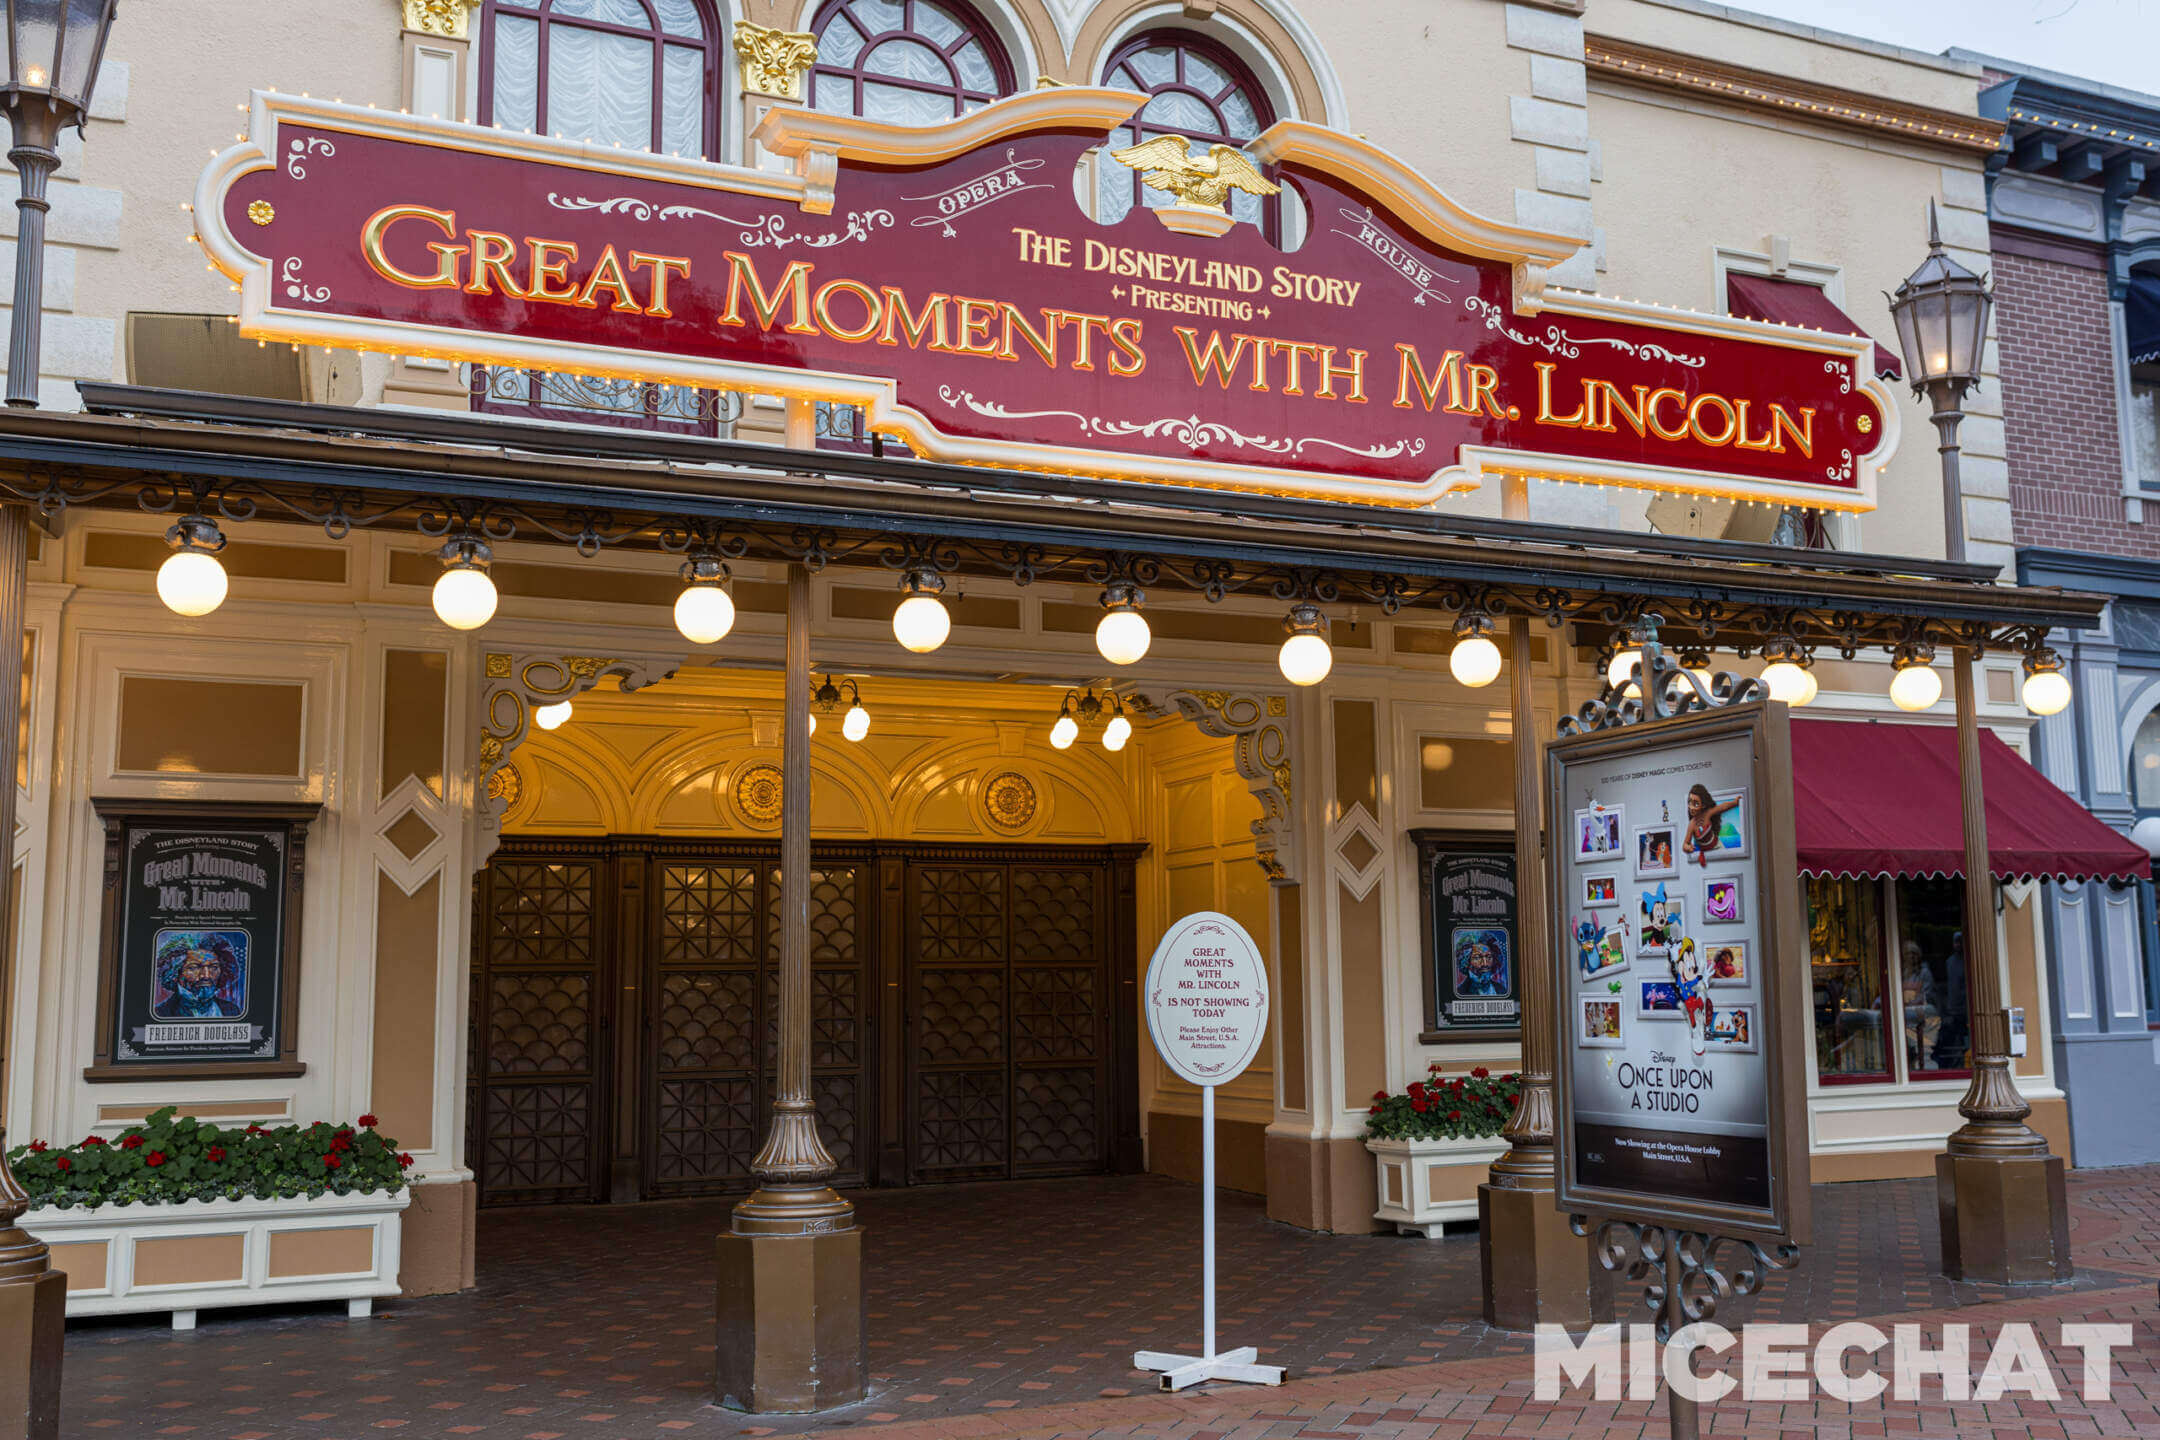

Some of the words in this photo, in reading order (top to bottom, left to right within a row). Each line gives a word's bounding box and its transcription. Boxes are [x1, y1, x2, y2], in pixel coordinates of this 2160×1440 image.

[938, 170, 1026, 215] OPERA
[1358, 224, 1433, 288] HOUSE
[1012, 227, 1073, 268] THE
[1084, 238, 1264, 294] DISNEYLAND
[1271, 265, 1362, 308] STORY
[1130, 284, 1253, 322] PRESENTING
[361, 203, 692, 319] GREAT
[720, 250, 1147, 378] MOMENTS
[1173, 324, 1370, 404] WITH
[1395, 343, 1521, 421] MR.
[1535, 361, 1817, 459] LINCOLN
[1649, 768, 1666, 777] MAGIC
[1685, 761, 1713, 771] TOGETHER
[154, 839, 174, 849] THE
[175, 836, 229, 846] DISNEYLAND
[230, 839, 259, 850] STORY
[143, 854, 190, 889] Great
[190, 852, 268, 890] Moments
[1442, 871, 1469, 896] Great
[1469, 869, 1515, 897] Moments
[190, 886, 251, 912] Lincoln
[1471, 895, 1507, 914] Lincoln
[1192, 948, 1226, 957] GREAT
[1184, 959, 1234, 968] MOMENTS
[1196, 970, 1222, 979] WITH
[1178, 981, 1196, 990] MR.
[1198, 981, 1240, 990] LINCOLN
[1168, 998, 1178, 1007] IS
[1180, 998, 1200, 1007] NOT
[1203, 998, 1250, 1007] SHOWING
[1192, 1009, 1226, 1018] TODAY
[149, 1027, 200, 1041] FREDERICK
[204, 1025, 249, 1041] DOUGLASS
[1201, 1026, 1219, 1034] Enjoy
[1650, 1050, 1677, 1066] Disney
[1618, 1062, 1664, 1089] ONCE
[1670, 1068, 1713, 1090] UPON
[1631, 1091, 1642, 1110] A
[1647, 1091, 1699, 1113] STUDIO
[1615, 1137, 1627, 1146] Now
[1627, 1138, 1651, 1150] Showing
[1657, 1141, 1666, 1150] the
[1666, 1143, 1684, 1152] Opera
[1684, 1144, 1702, 1154] House
[1703, 1146, 1721, 1158] Lobby
[1642, 1151, 1657, 1159] Main
